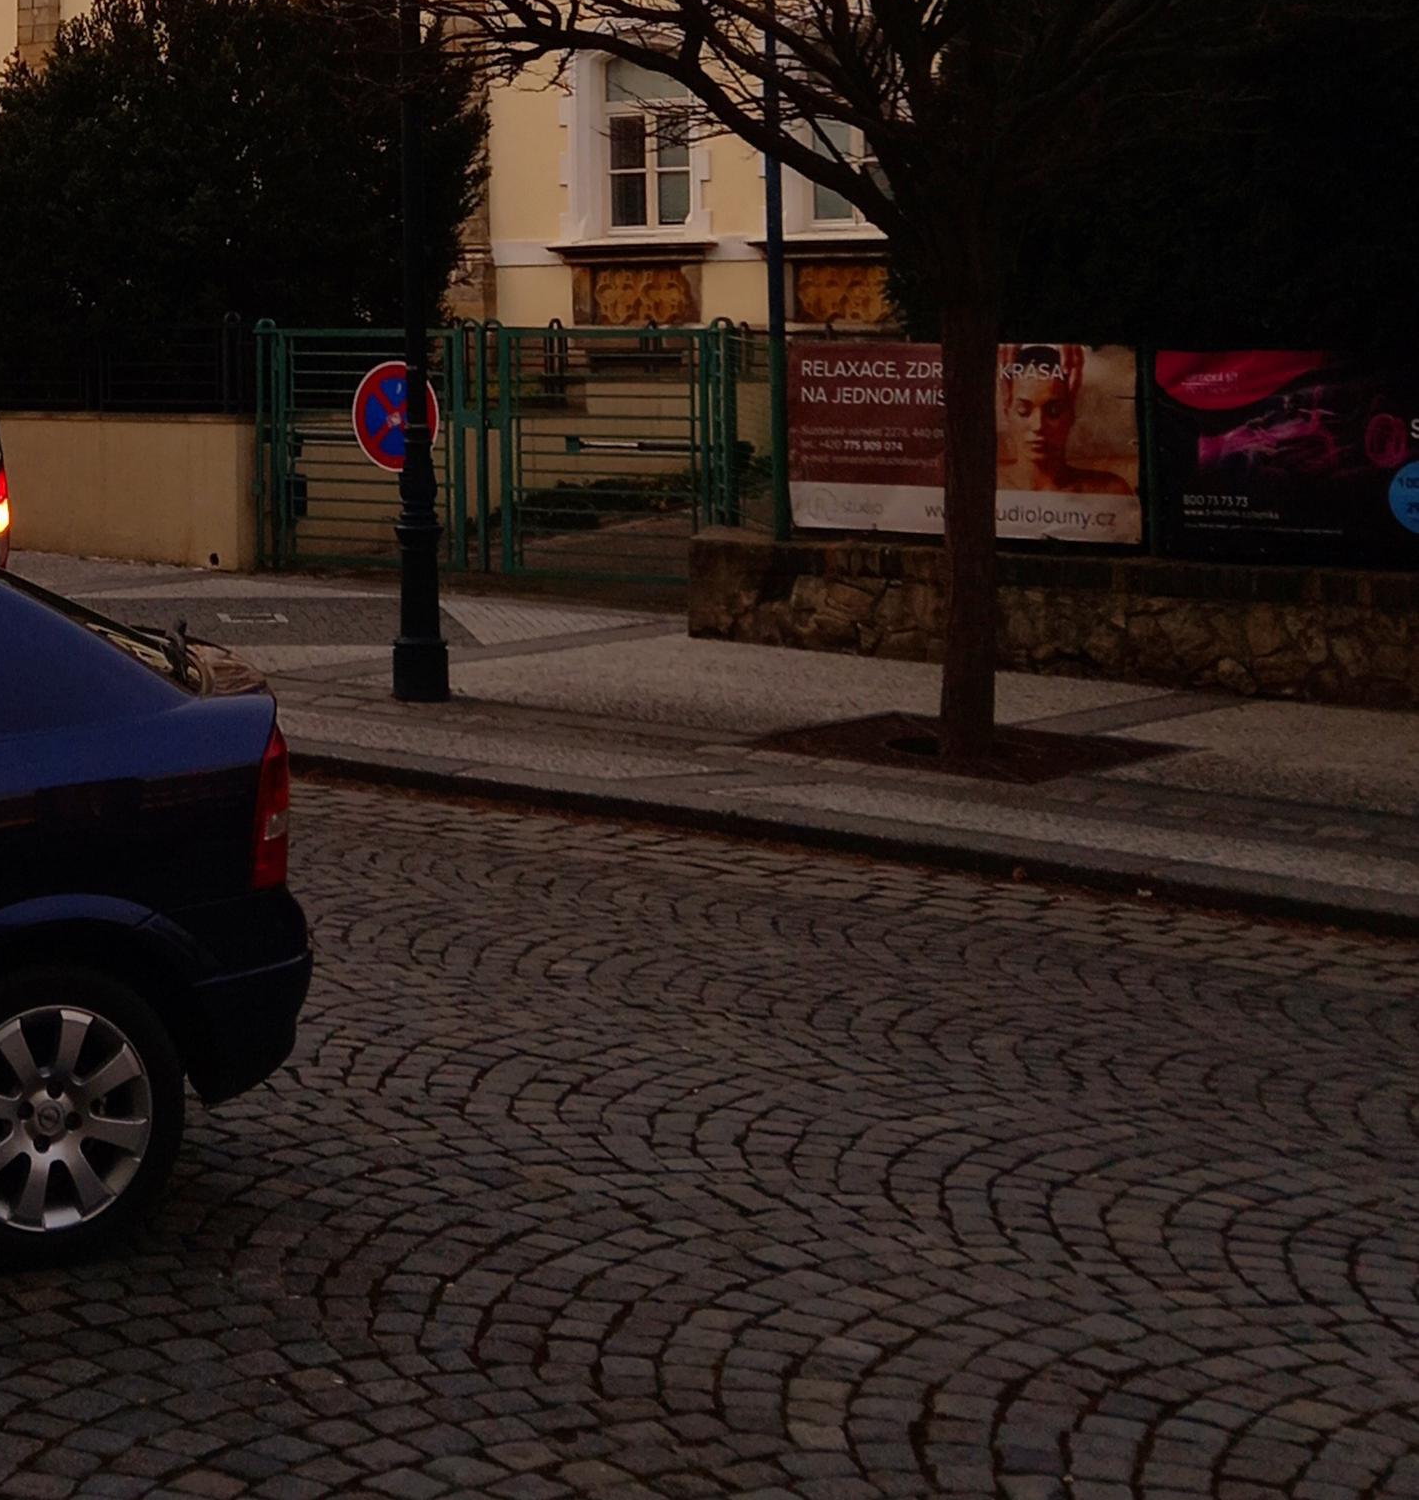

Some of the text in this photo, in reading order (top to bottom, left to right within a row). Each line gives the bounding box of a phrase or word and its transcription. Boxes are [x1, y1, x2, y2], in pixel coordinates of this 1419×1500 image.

[801, 359, 1064, 380] RELAXACE, ZDR KRÁSA
[800, 384, 947, 407] NA JEDNOM MÍS
[843, 440, 861, 451] 775
